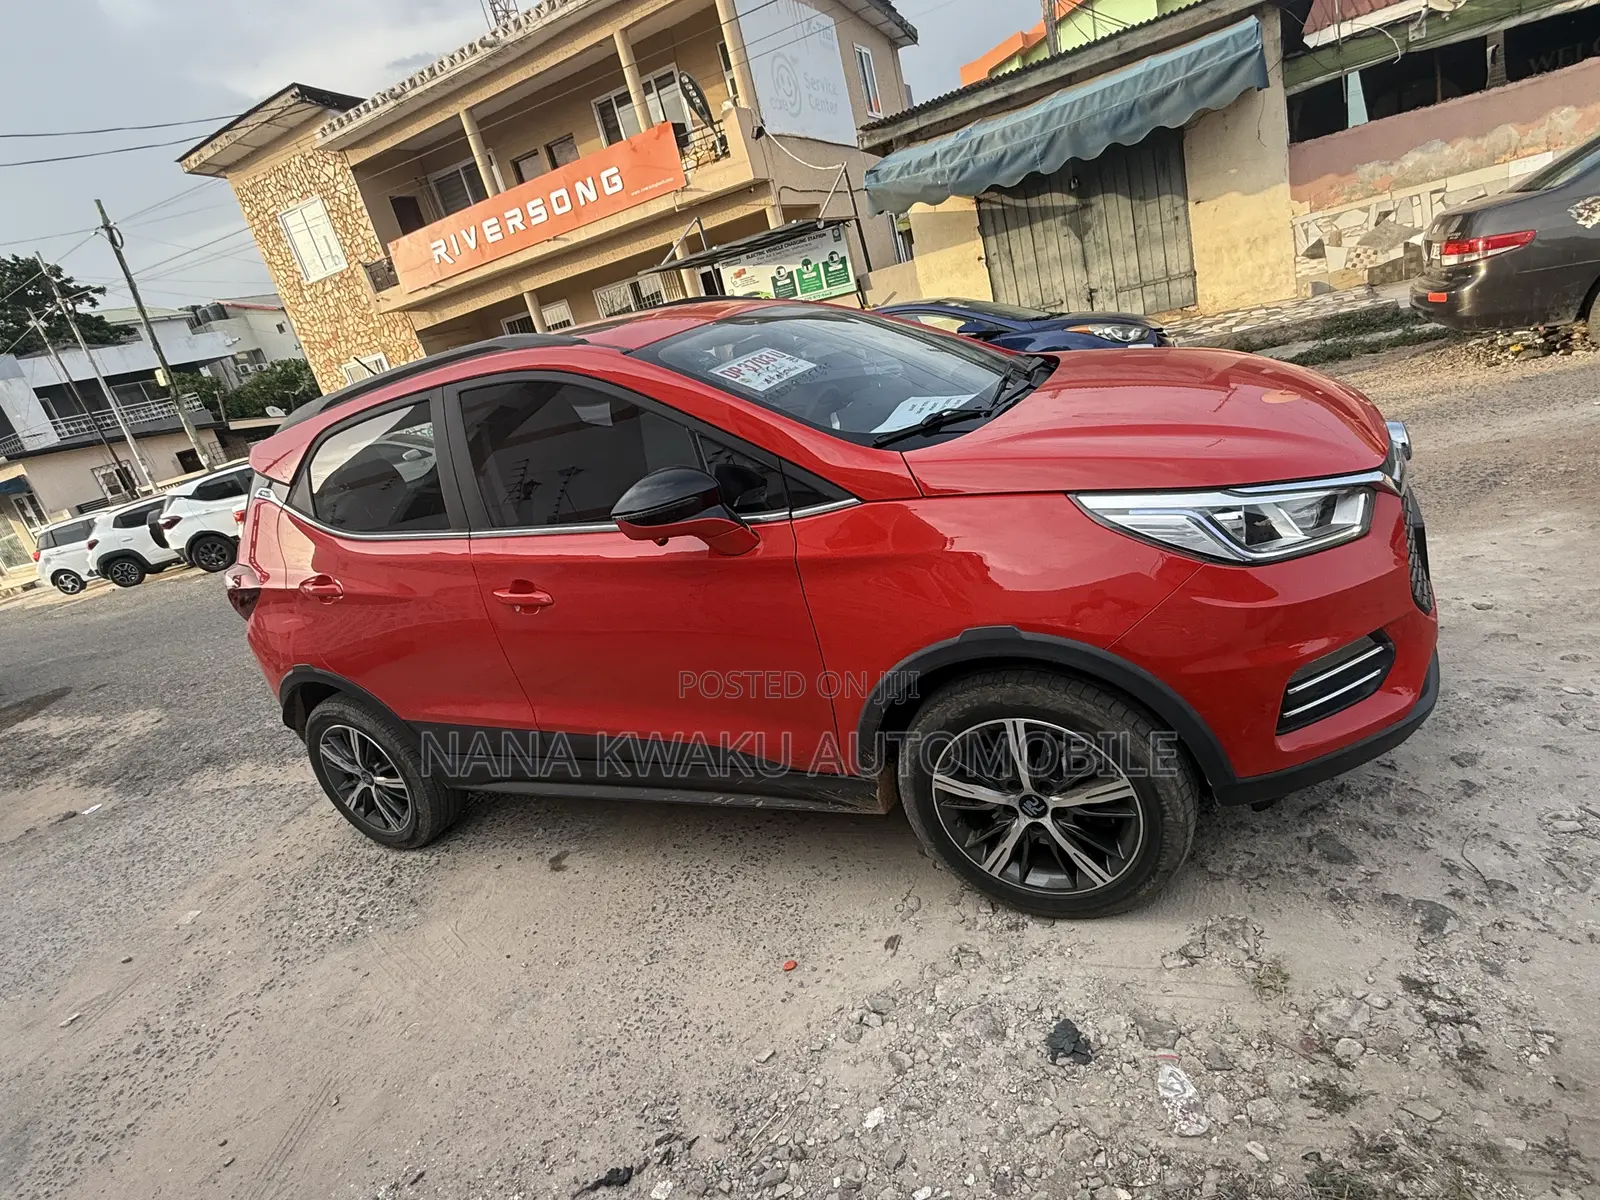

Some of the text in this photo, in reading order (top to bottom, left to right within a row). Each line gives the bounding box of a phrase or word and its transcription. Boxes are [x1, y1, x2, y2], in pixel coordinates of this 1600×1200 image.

[804, 72, 838, 95] Service
[807, 93, 838, 115] Center
[430, 166, 625, 264] RIVERSONG
[746, 250, 765, 259] ELECTRIC
[766, 245, 784, 255] VEHICLE
[784, 239, 807, 250] CHARGING
[807, 233, 826, 242] STATION
[719, 367, 745, 380] DP
